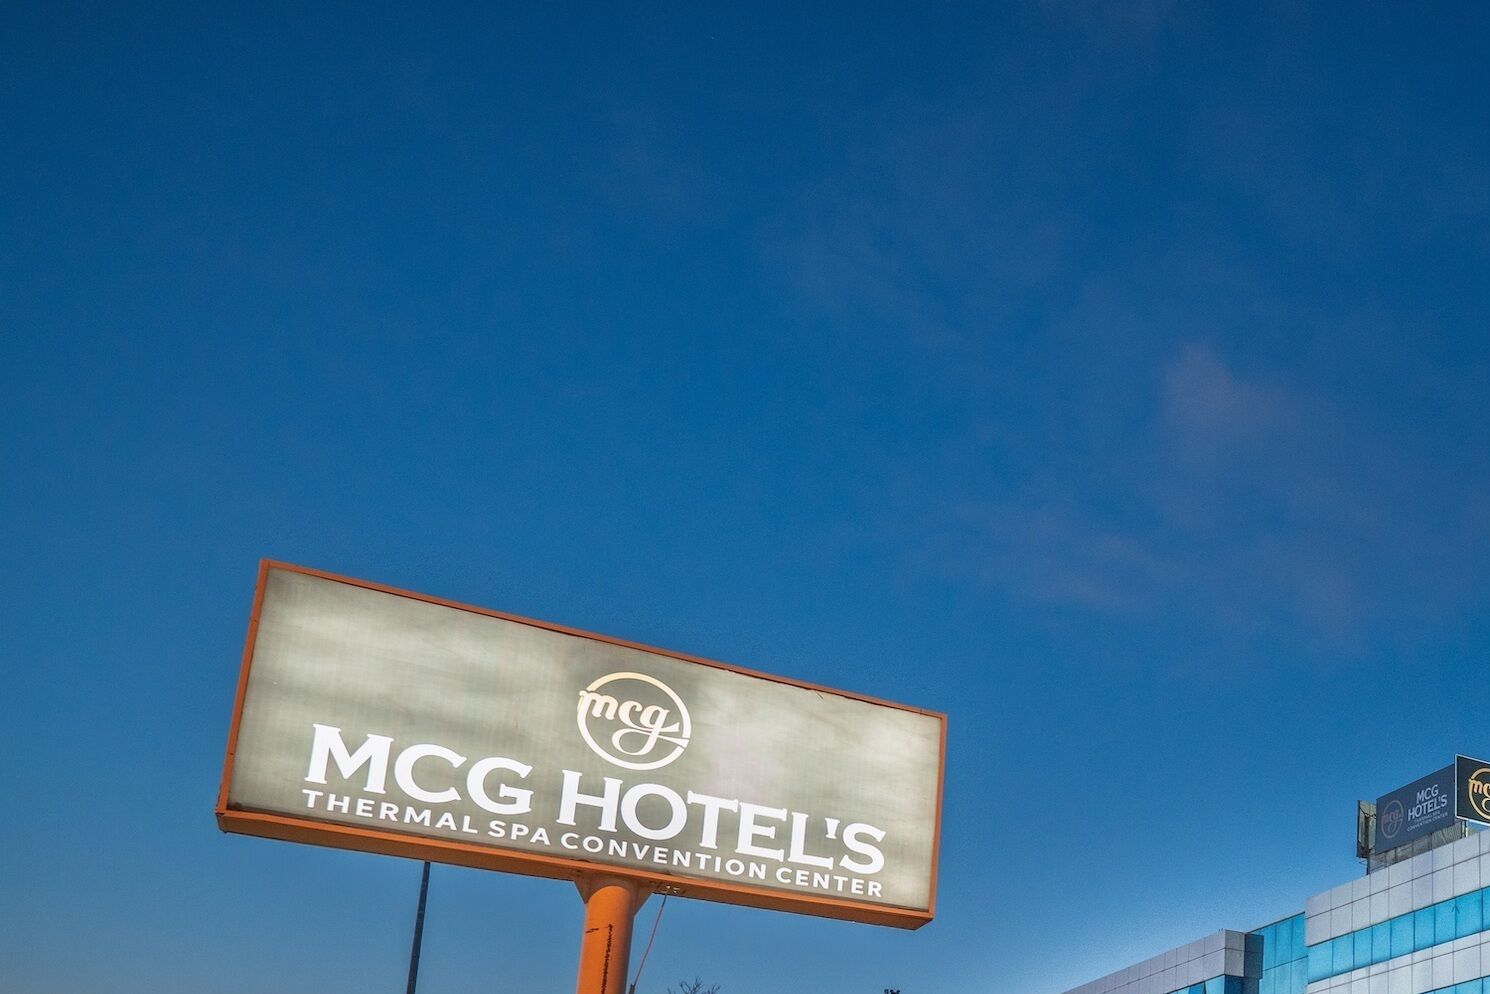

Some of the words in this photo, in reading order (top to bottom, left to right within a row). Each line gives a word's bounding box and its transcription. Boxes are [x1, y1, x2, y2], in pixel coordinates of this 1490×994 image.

[304, 723, 534, 815] MCG
[556, 768, 888, 875] HOTEL'S
[1407, 794, 1448, 821] HOTEL'S
[1416, 784, 1440, 804] MCG
[301, 788, 479, 835] THERMAL
[488, 820, 552, 847] SPA
[560, 831, 767, 881] CONVENTION
[775, 867, 884, 898] CENTER
